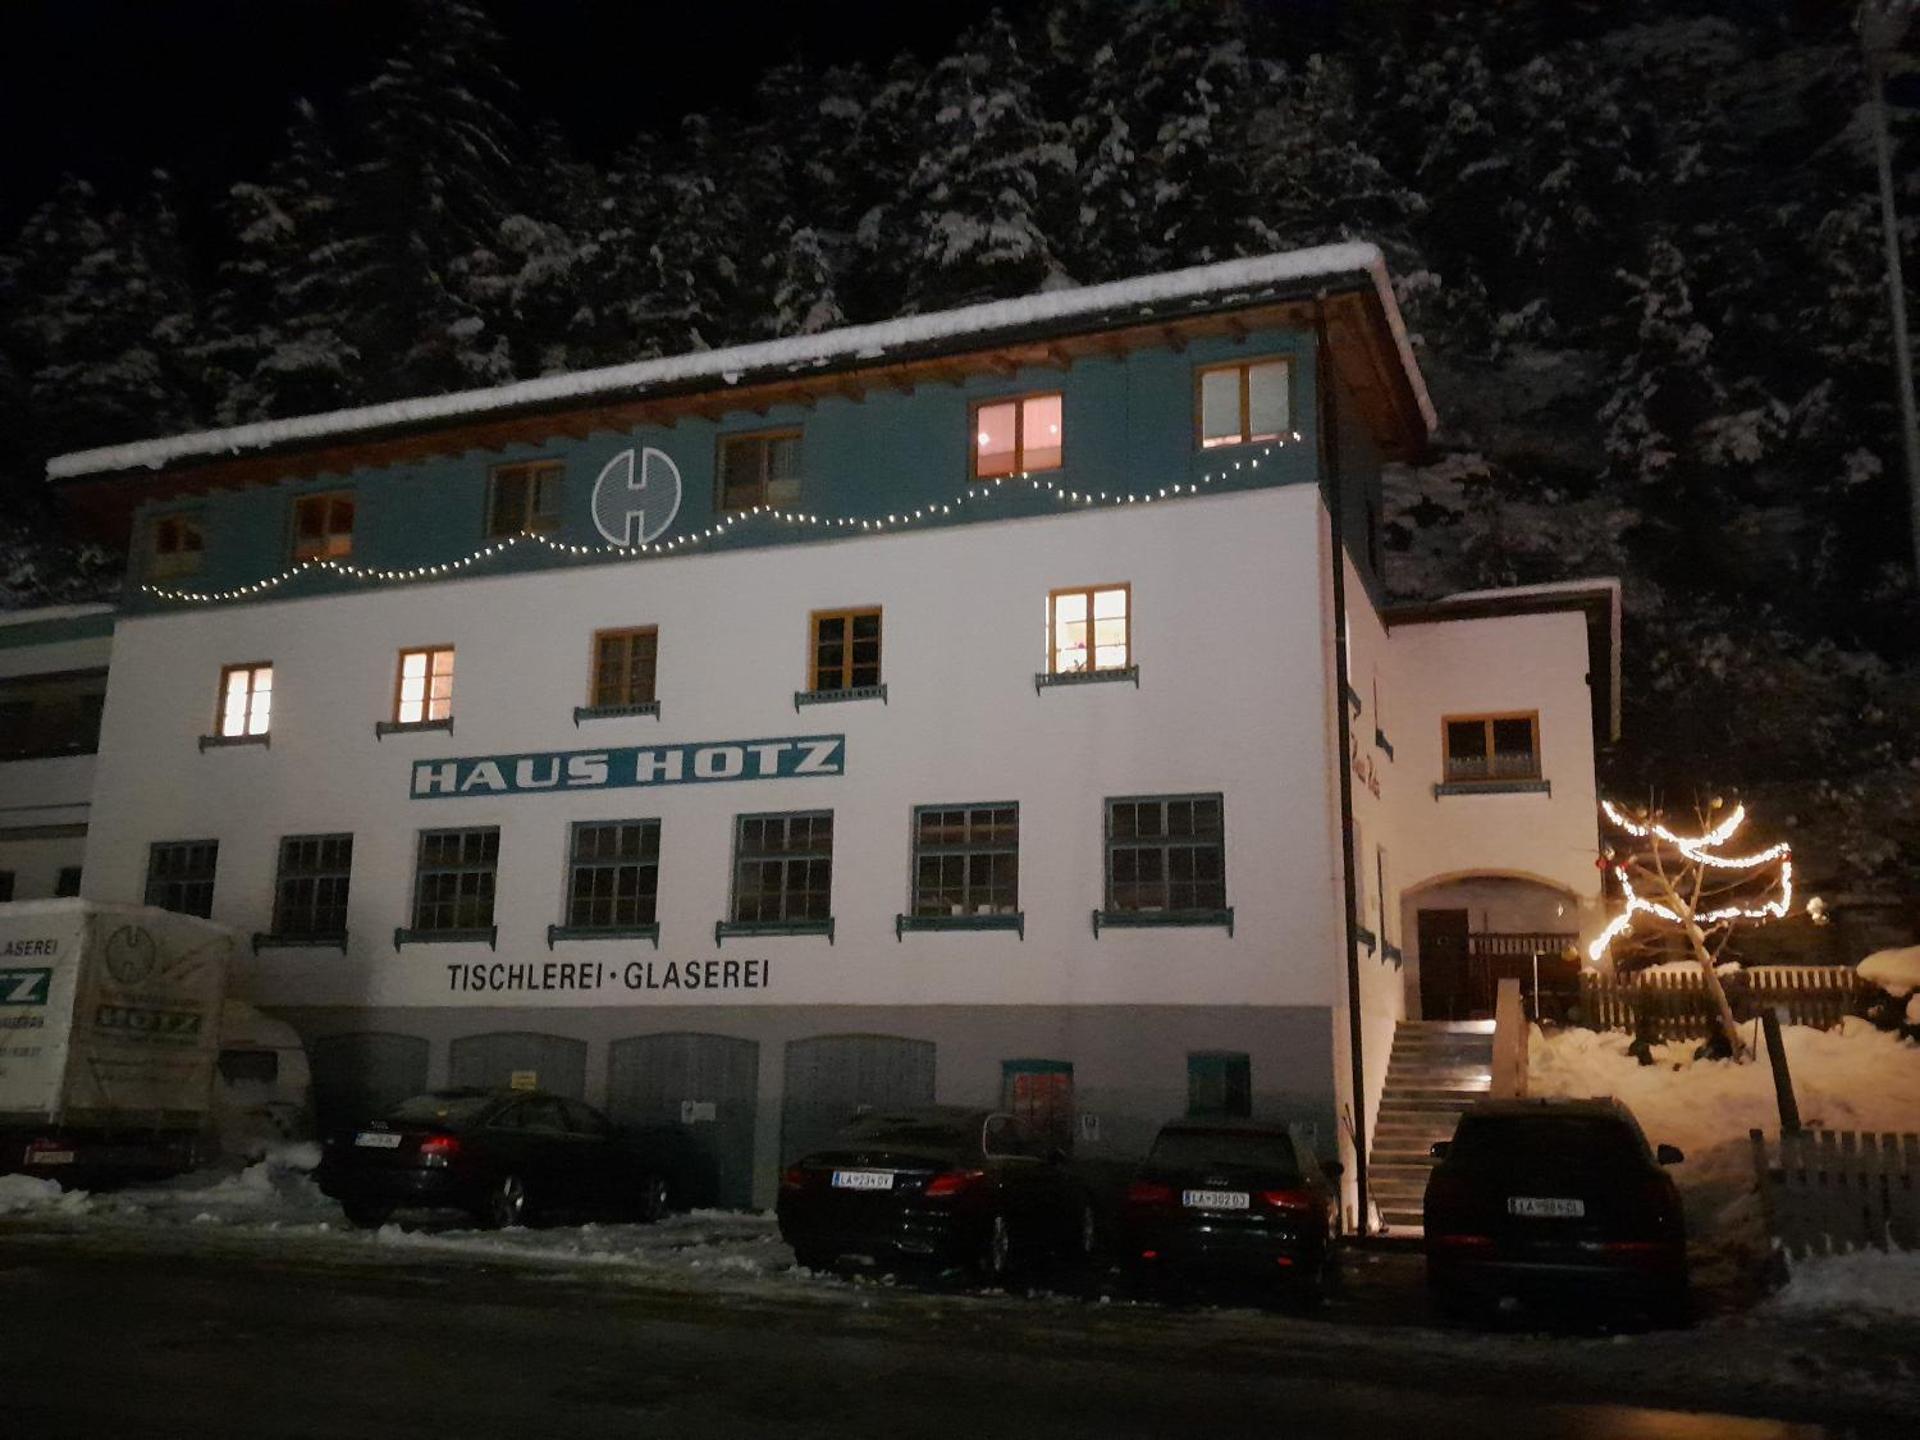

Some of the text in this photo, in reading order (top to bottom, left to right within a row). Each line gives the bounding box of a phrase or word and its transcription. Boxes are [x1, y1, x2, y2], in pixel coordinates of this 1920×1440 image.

[415, 739, 841, 794] HAUS HOTZ
[0, 939, 58, 957] ASEREI
[446, 960, 769, 992] TISCHLEREI GLASEREI
